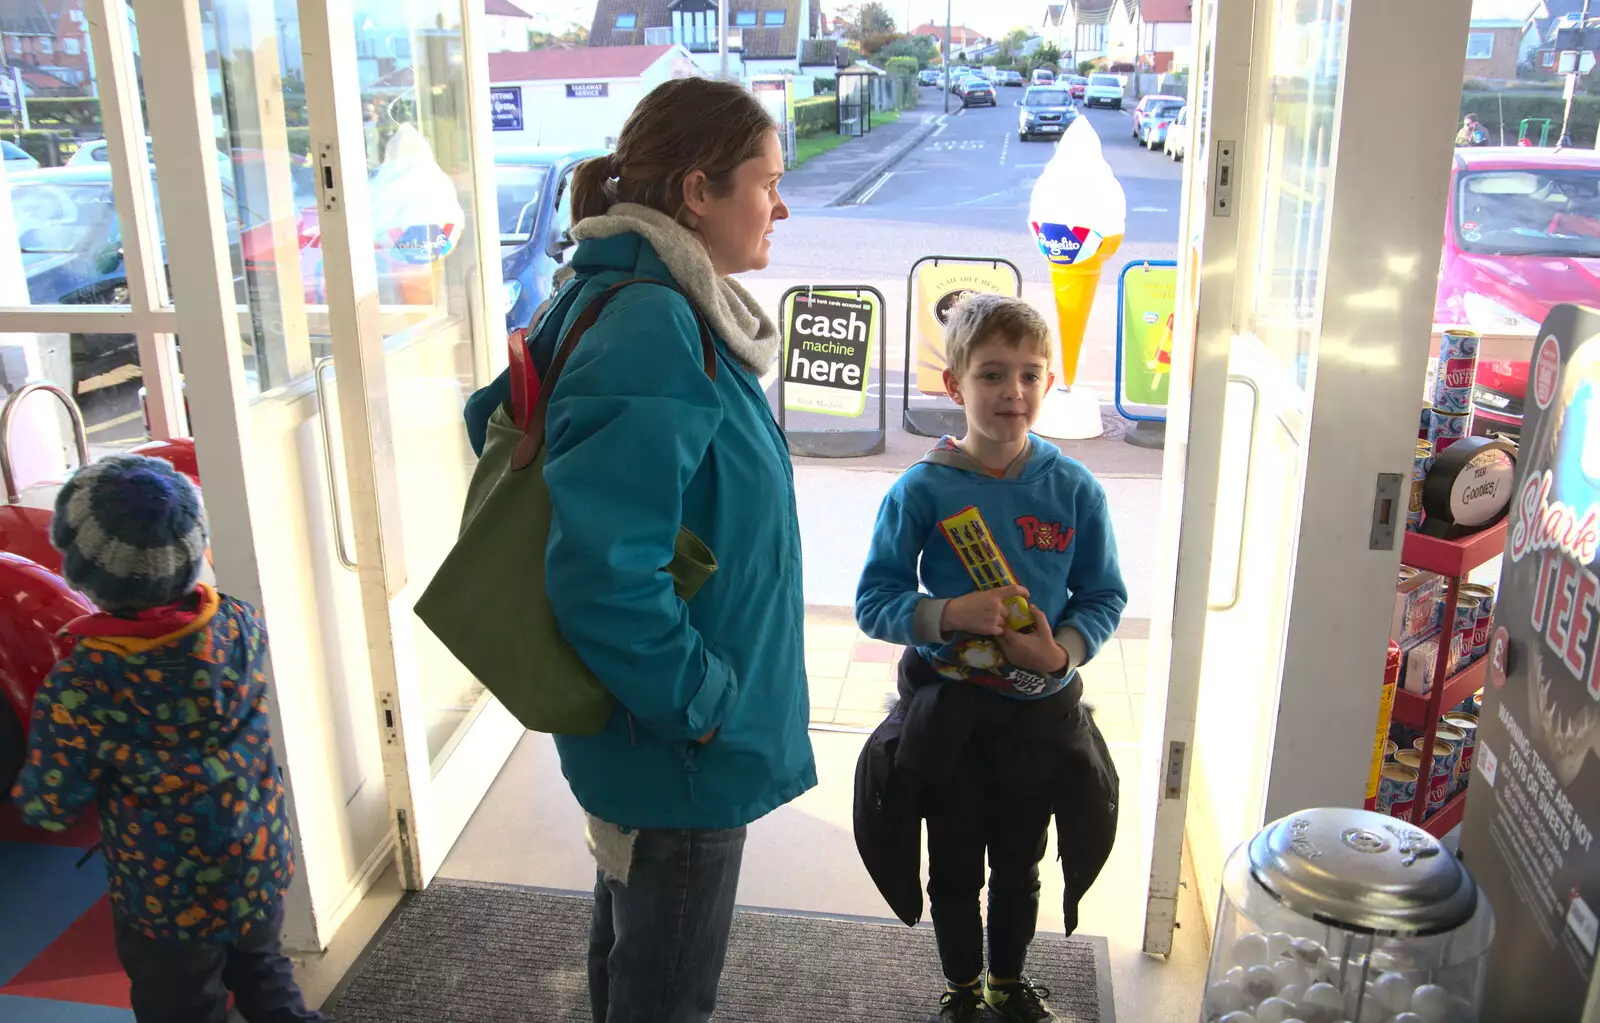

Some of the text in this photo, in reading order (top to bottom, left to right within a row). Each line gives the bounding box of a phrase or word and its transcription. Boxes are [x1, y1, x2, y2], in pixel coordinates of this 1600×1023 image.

[795, 311, 867, 342] cash
[790, 348, 861, 386] here
[802, 340, 855, 356] machine
[1474, 467, 1487, 479] PIER
[1512, 469, 1597, 565] Shark
[1499, 702, 1594, 852] WARNING: THESE ARE NOT
[1509, 743, 1571, 851] TOYS OR SWEETS
